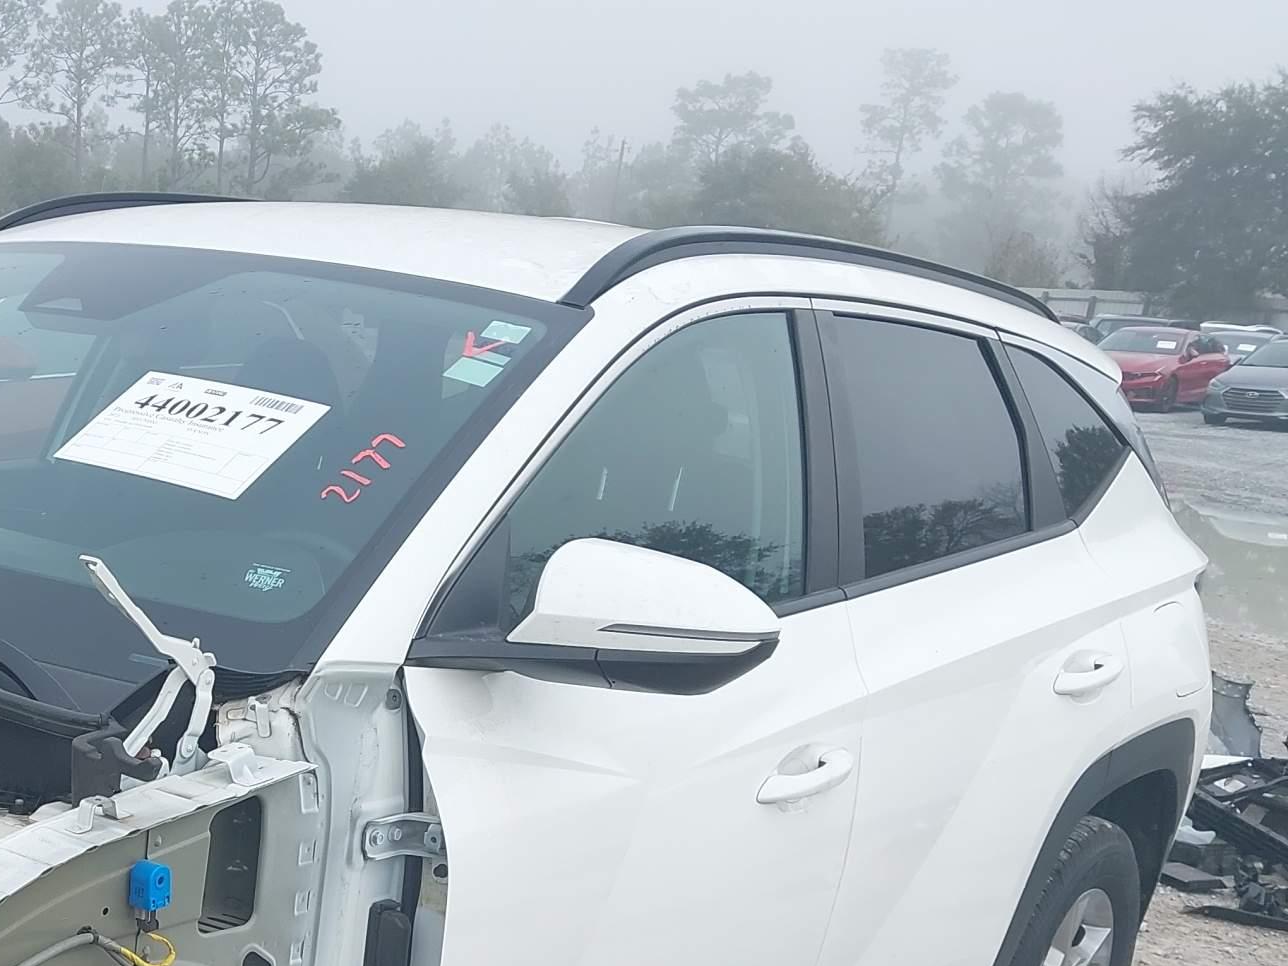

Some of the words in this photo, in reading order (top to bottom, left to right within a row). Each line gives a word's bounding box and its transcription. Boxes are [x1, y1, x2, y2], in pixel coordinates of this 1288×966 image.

[134, 393, 286, 436] 44002177
[321, 433, 406, 503] 2177
[244, 571, 286, 589] WERNER
